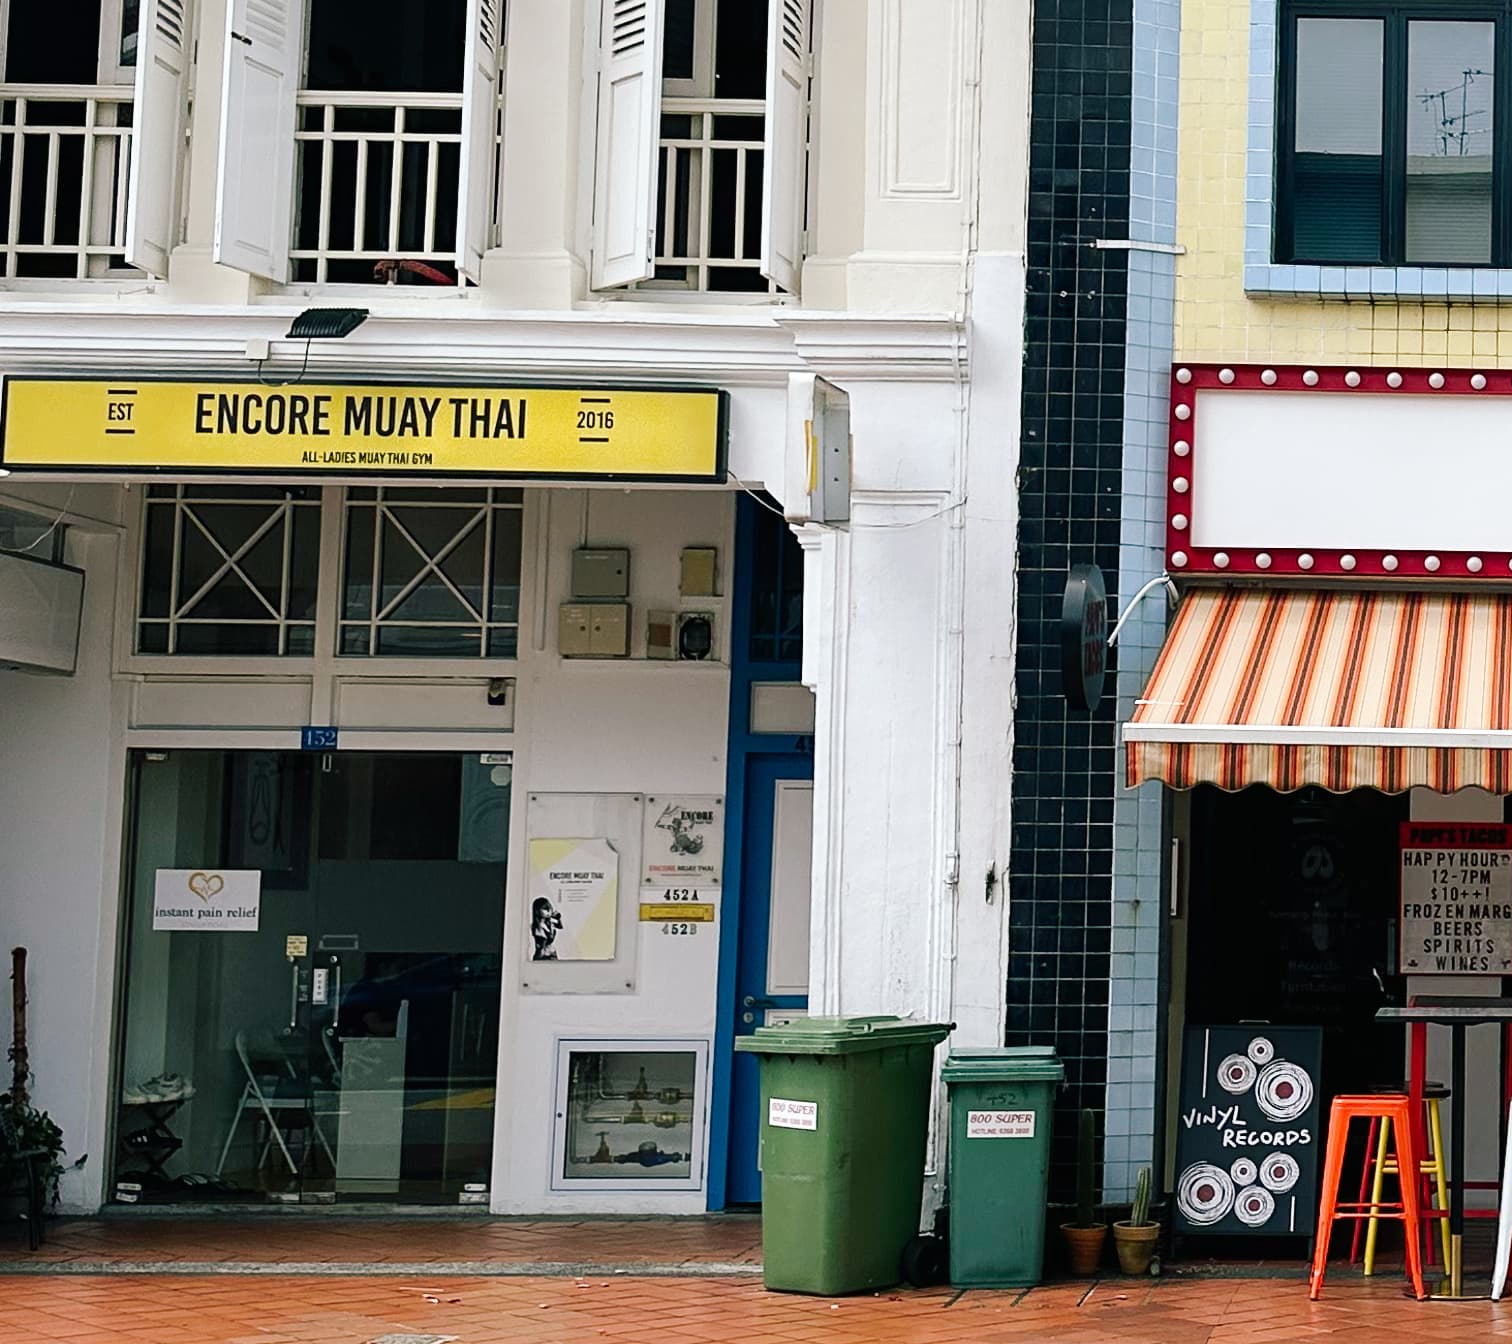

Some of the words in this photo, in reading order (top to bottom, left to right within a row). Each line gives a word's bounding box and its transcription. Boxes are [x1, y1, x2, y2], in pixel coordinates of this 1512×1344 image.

[108, 403, 134, 422] EST
[195, 393, 330, 437] ENCORE
[344, 396, 441, 438] MUAY
[449, 398, 526, 440] THAI
[577, 411, 614, 430] 2016
[302, 451, 356, 464] ALL-LADIES
[359, 452, 385, 464] MUAY
[387, 452, 410, 465] THAI
[412, 453, 433, 465] GYM
[681, 810, 714, 821] ENCORE
[1460, 828, 1507, 844] TACOS
[1460, 852, 1499, 867] HOUR
[156, 906, 194, 918] instant
[198, 906, 223, 919] pain
[227, 906, 257, 918] relief
[1469, 904, 1512, 919] MARG
[662, 923, 697, 936] 452B
[1434, 921, 1482, 936] BEERS
[1424, 939, 1495, 954] SPIRITS
[1436, 956, 1489, 971] WINES
[788, 1104, 815, 1115] SUPER
[970, 1114, 992, 1124] 800
[995, 1114, 1032, 1124] SUPER
[1183, 1105, 1247, 1131] VINYL
[1223, 1128, 1311, 1148] RECORDS
